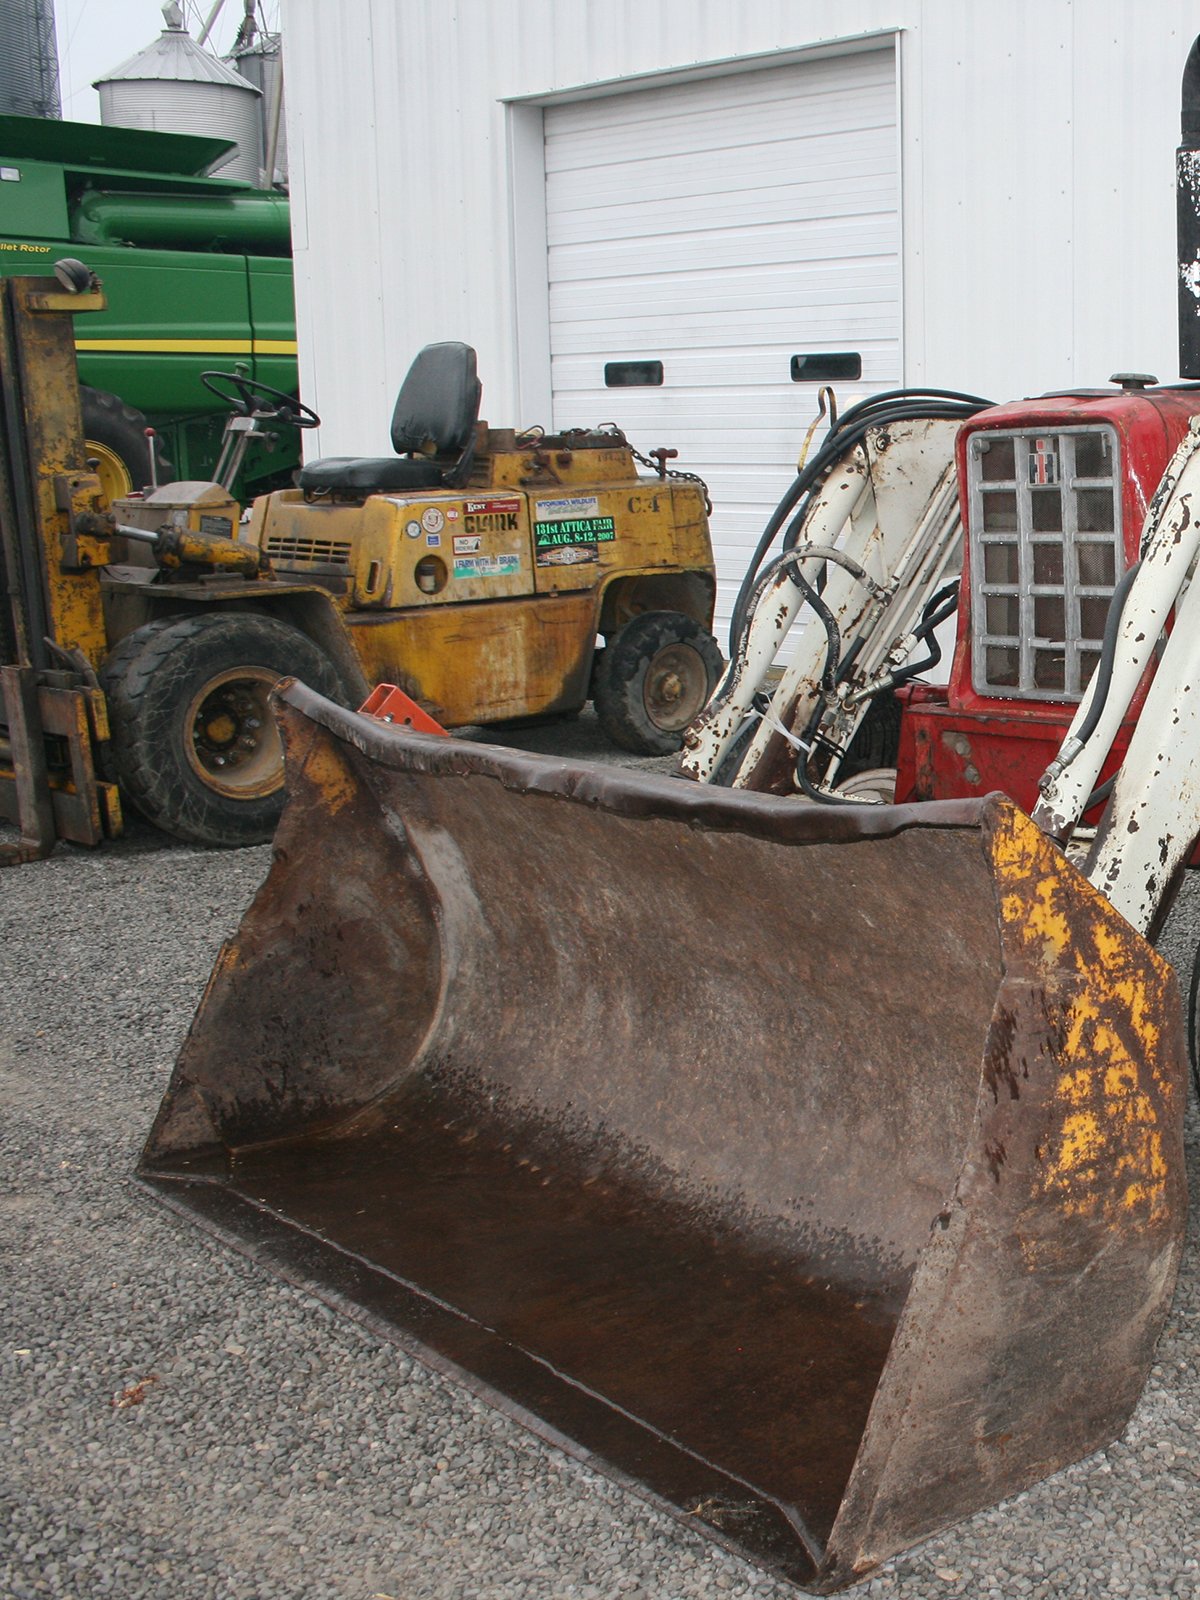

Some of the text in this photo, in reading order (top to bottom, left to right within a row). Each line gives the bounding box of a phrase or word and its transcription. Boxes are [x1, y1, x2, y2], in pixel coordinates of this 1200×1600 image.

[20, 244, 51, 253] Rotor
[464, 512, 518, 533] CLARK
[536, 518, 613, 535] 131st ATTICA FAIR
[552, 533, 573, 544] AUG.
[597, 531, 614, 541] 2007
